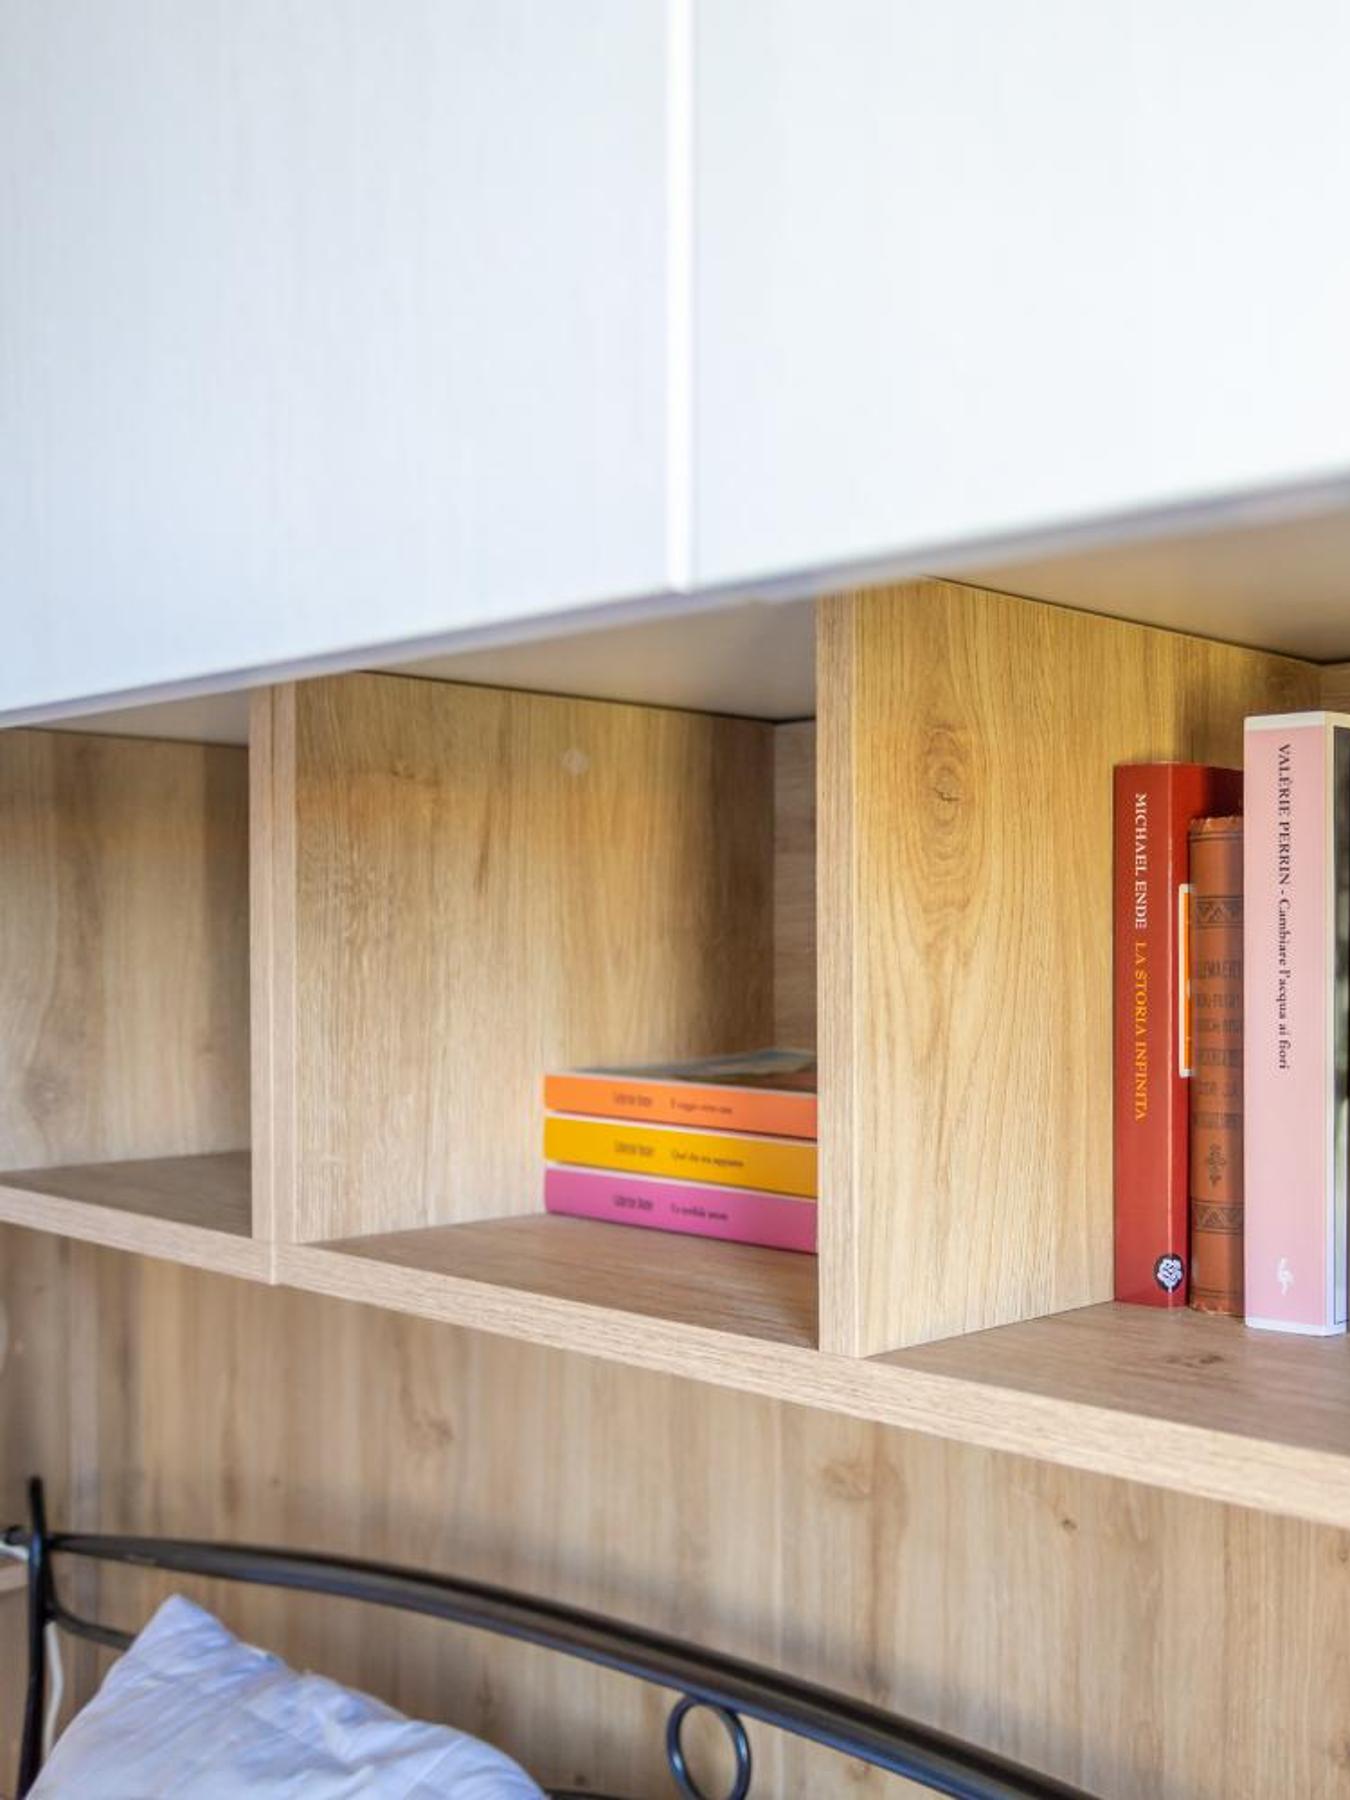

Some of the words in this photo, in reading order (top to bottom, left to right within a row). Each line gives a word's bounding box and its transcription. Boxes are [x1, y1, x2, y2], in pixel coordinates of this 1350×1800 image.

[1135, 793, 1148, 876] MICHAEL
[1278, 821, 1292, 885] PERRIN
[1135, 880, 1148, 929] ENDE
[1278, 898, 1291, 966] Cambiare
[1135, 942, 1146, 965] LA
[1135, 970, 1147, 1036] STORIA
[1278, 1023, 1289, 1036] ai
[1135, 1041, 1147, 1120] INFINITA
[1278, 1039, 1291, 1069] fiori
